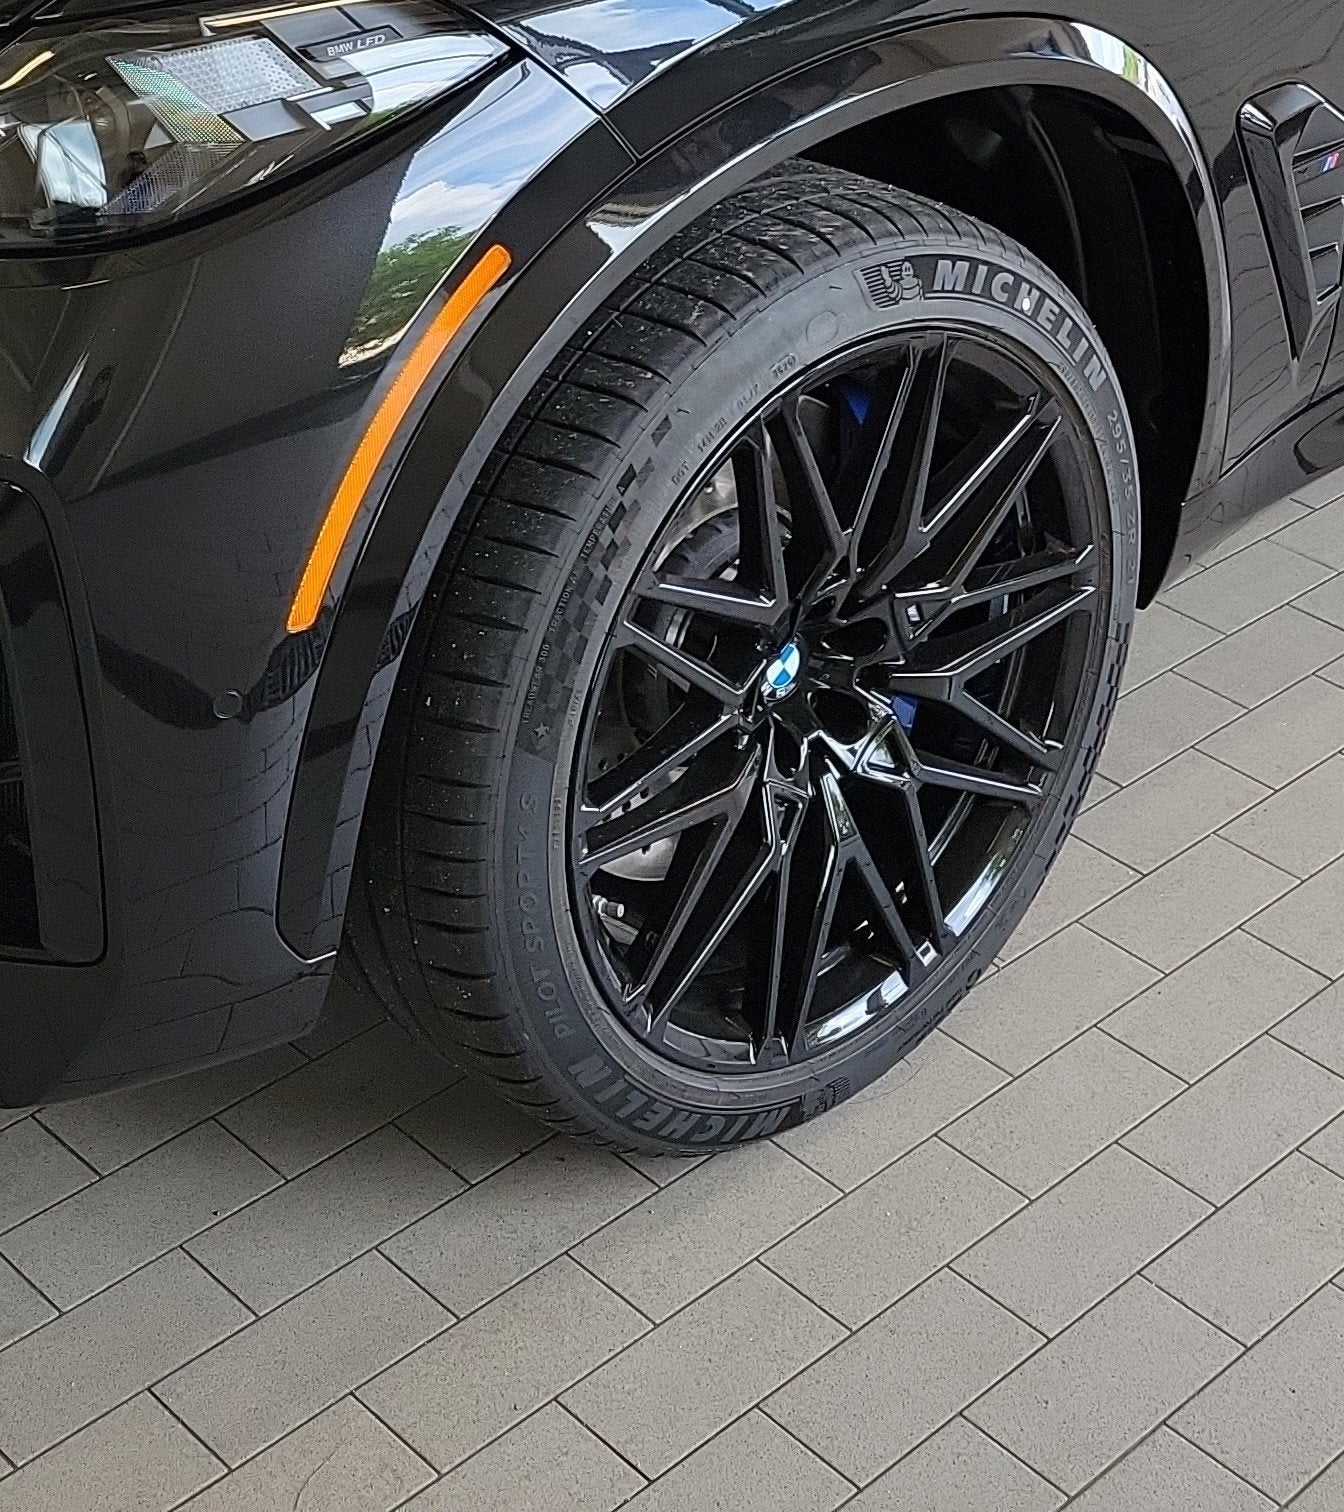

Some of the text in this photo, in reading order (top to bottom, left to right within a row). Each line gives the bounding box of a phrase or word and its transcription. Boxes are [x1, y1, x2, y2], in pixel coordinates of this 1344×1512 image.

[327, 41, 354, 57] BMW
[933, 259, 1107, 392] MICHELIN
[1106, 409, 1136, 500] 295/35
[1123, 512, 1136, 545] ZR
[549, 586, 573, 633] TRACTION
[516, 843, 545, 953] SPORT
[528, 964, 575, 1039] PILOT
[567, 1055, 791, 1143] MICHELIN
